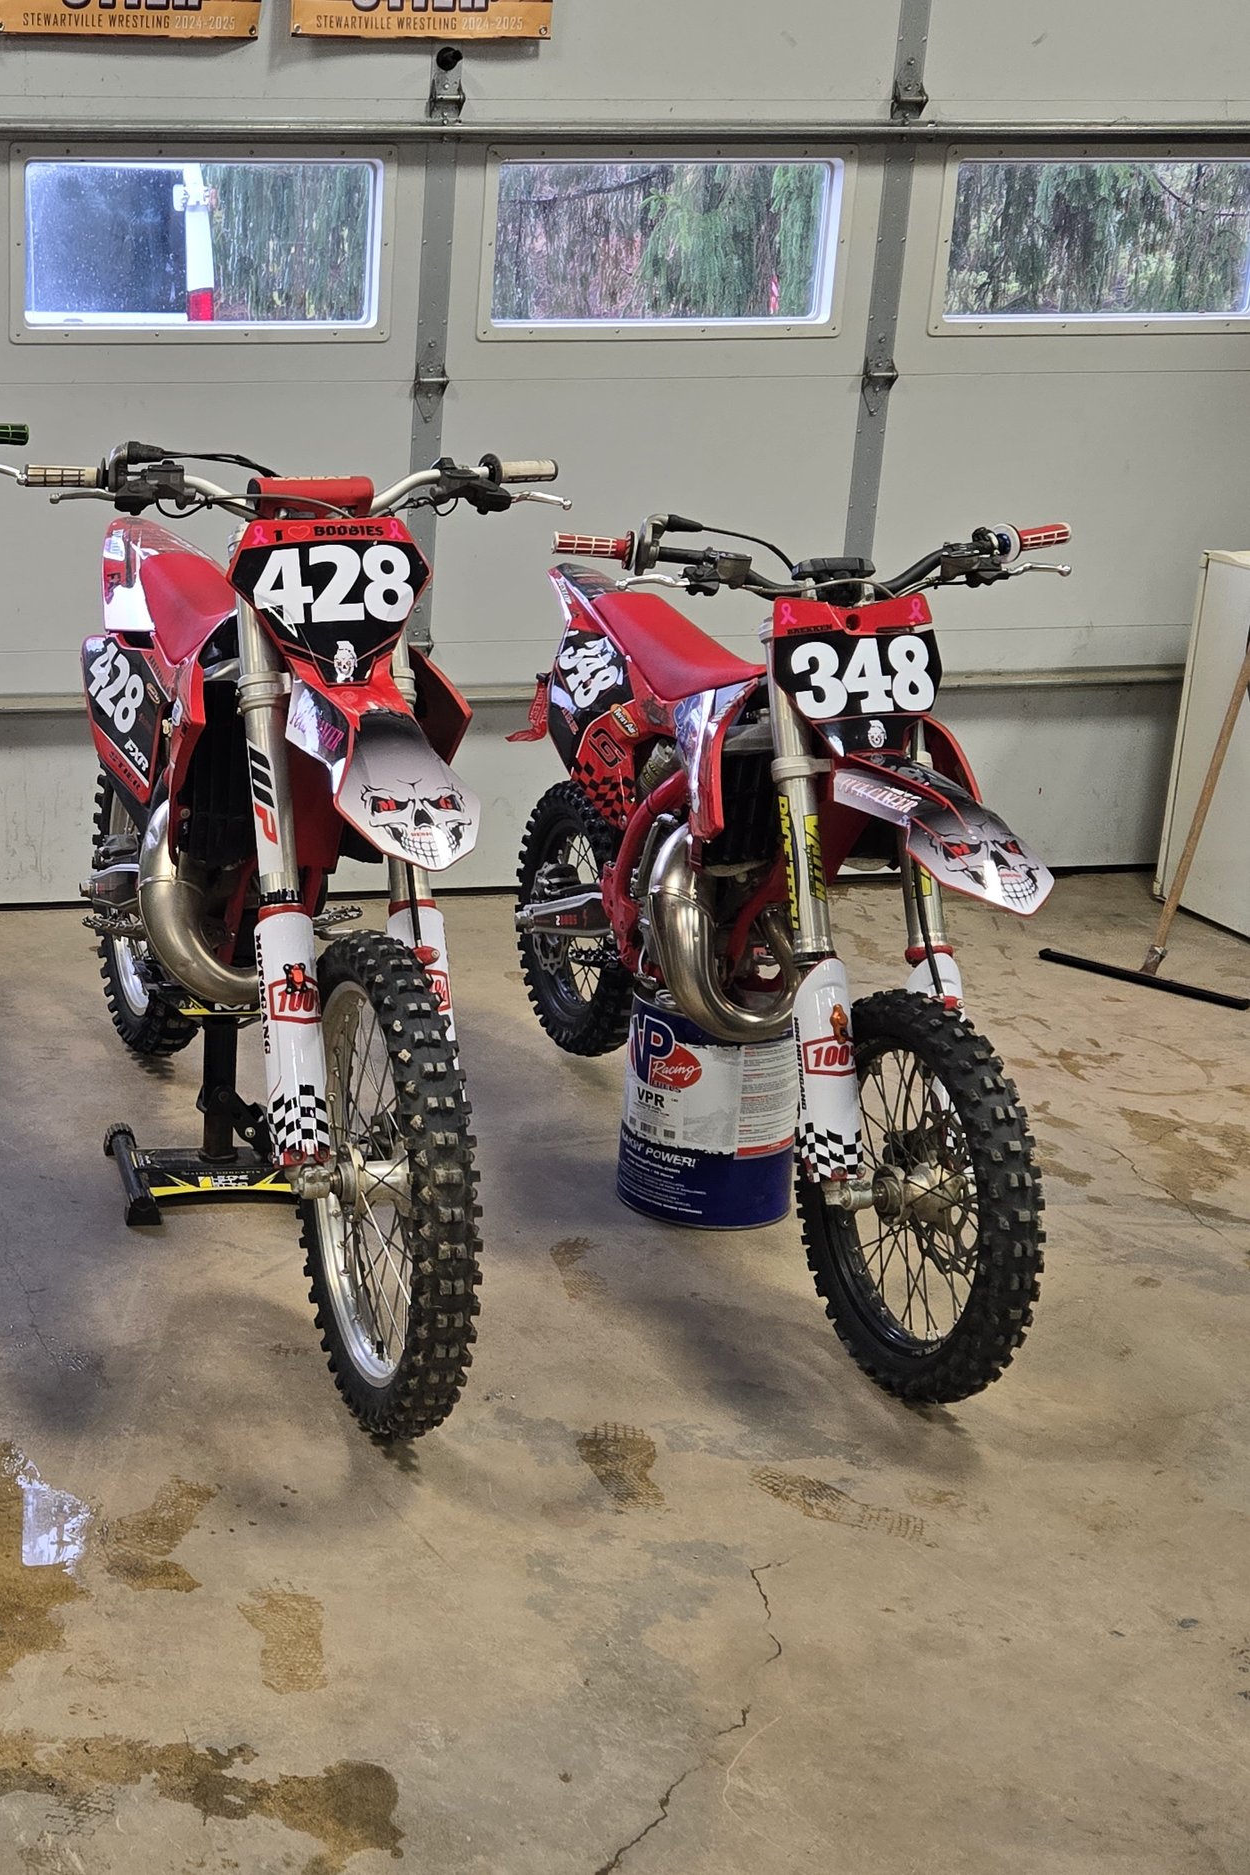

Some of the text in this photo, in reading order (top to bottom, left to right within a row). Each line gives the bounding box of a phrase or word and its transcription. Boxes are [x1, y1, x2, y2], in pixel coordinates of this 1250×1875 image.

[22, 12, 236, 30] STEWARTVILLE WRESTLING 2024-2025
[316, 14, 523, 31] STEWARTVILLE WRESTLING 2024-2025
[274, 525, 384, 542] I BOOBIES
[253, 543, 414, 625] 428
[88, 642, 145, 734] 428
[790, 635, 935, 719] 348
[614, 707, 628, 727] Twin
[124, 738, 149, 772] FXR
[109, 752, 141, 791] STIER
[278, 987, 322, 1013] 100%
[629, 1013, 675, 1085] VP
[652, 1060, 701, 1082] Racing
[637, 1086, 665, 1108] VPR
[645, 1146, 696, 1168] POWER!
